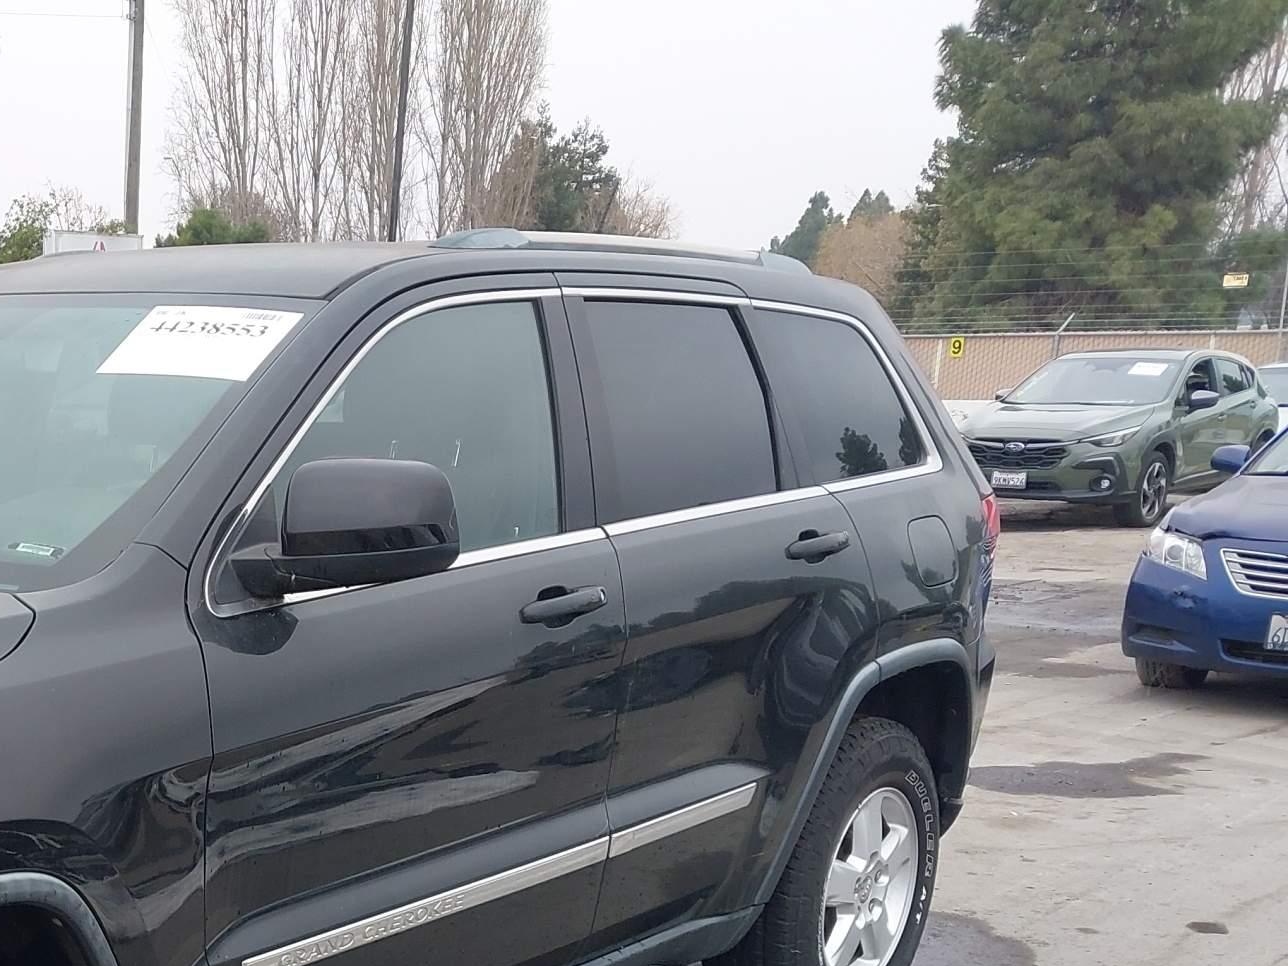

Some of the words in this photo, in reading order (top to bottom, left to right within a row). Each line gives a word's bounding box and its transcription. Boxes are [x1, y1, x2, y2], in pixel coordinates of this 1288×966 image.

[149, 320, 270, 338] 44238553
[952, 339, 962, 355] 9
[905, 769, 935, 878] DUELER
[362, 894, 465, 942] CHEROKEE
